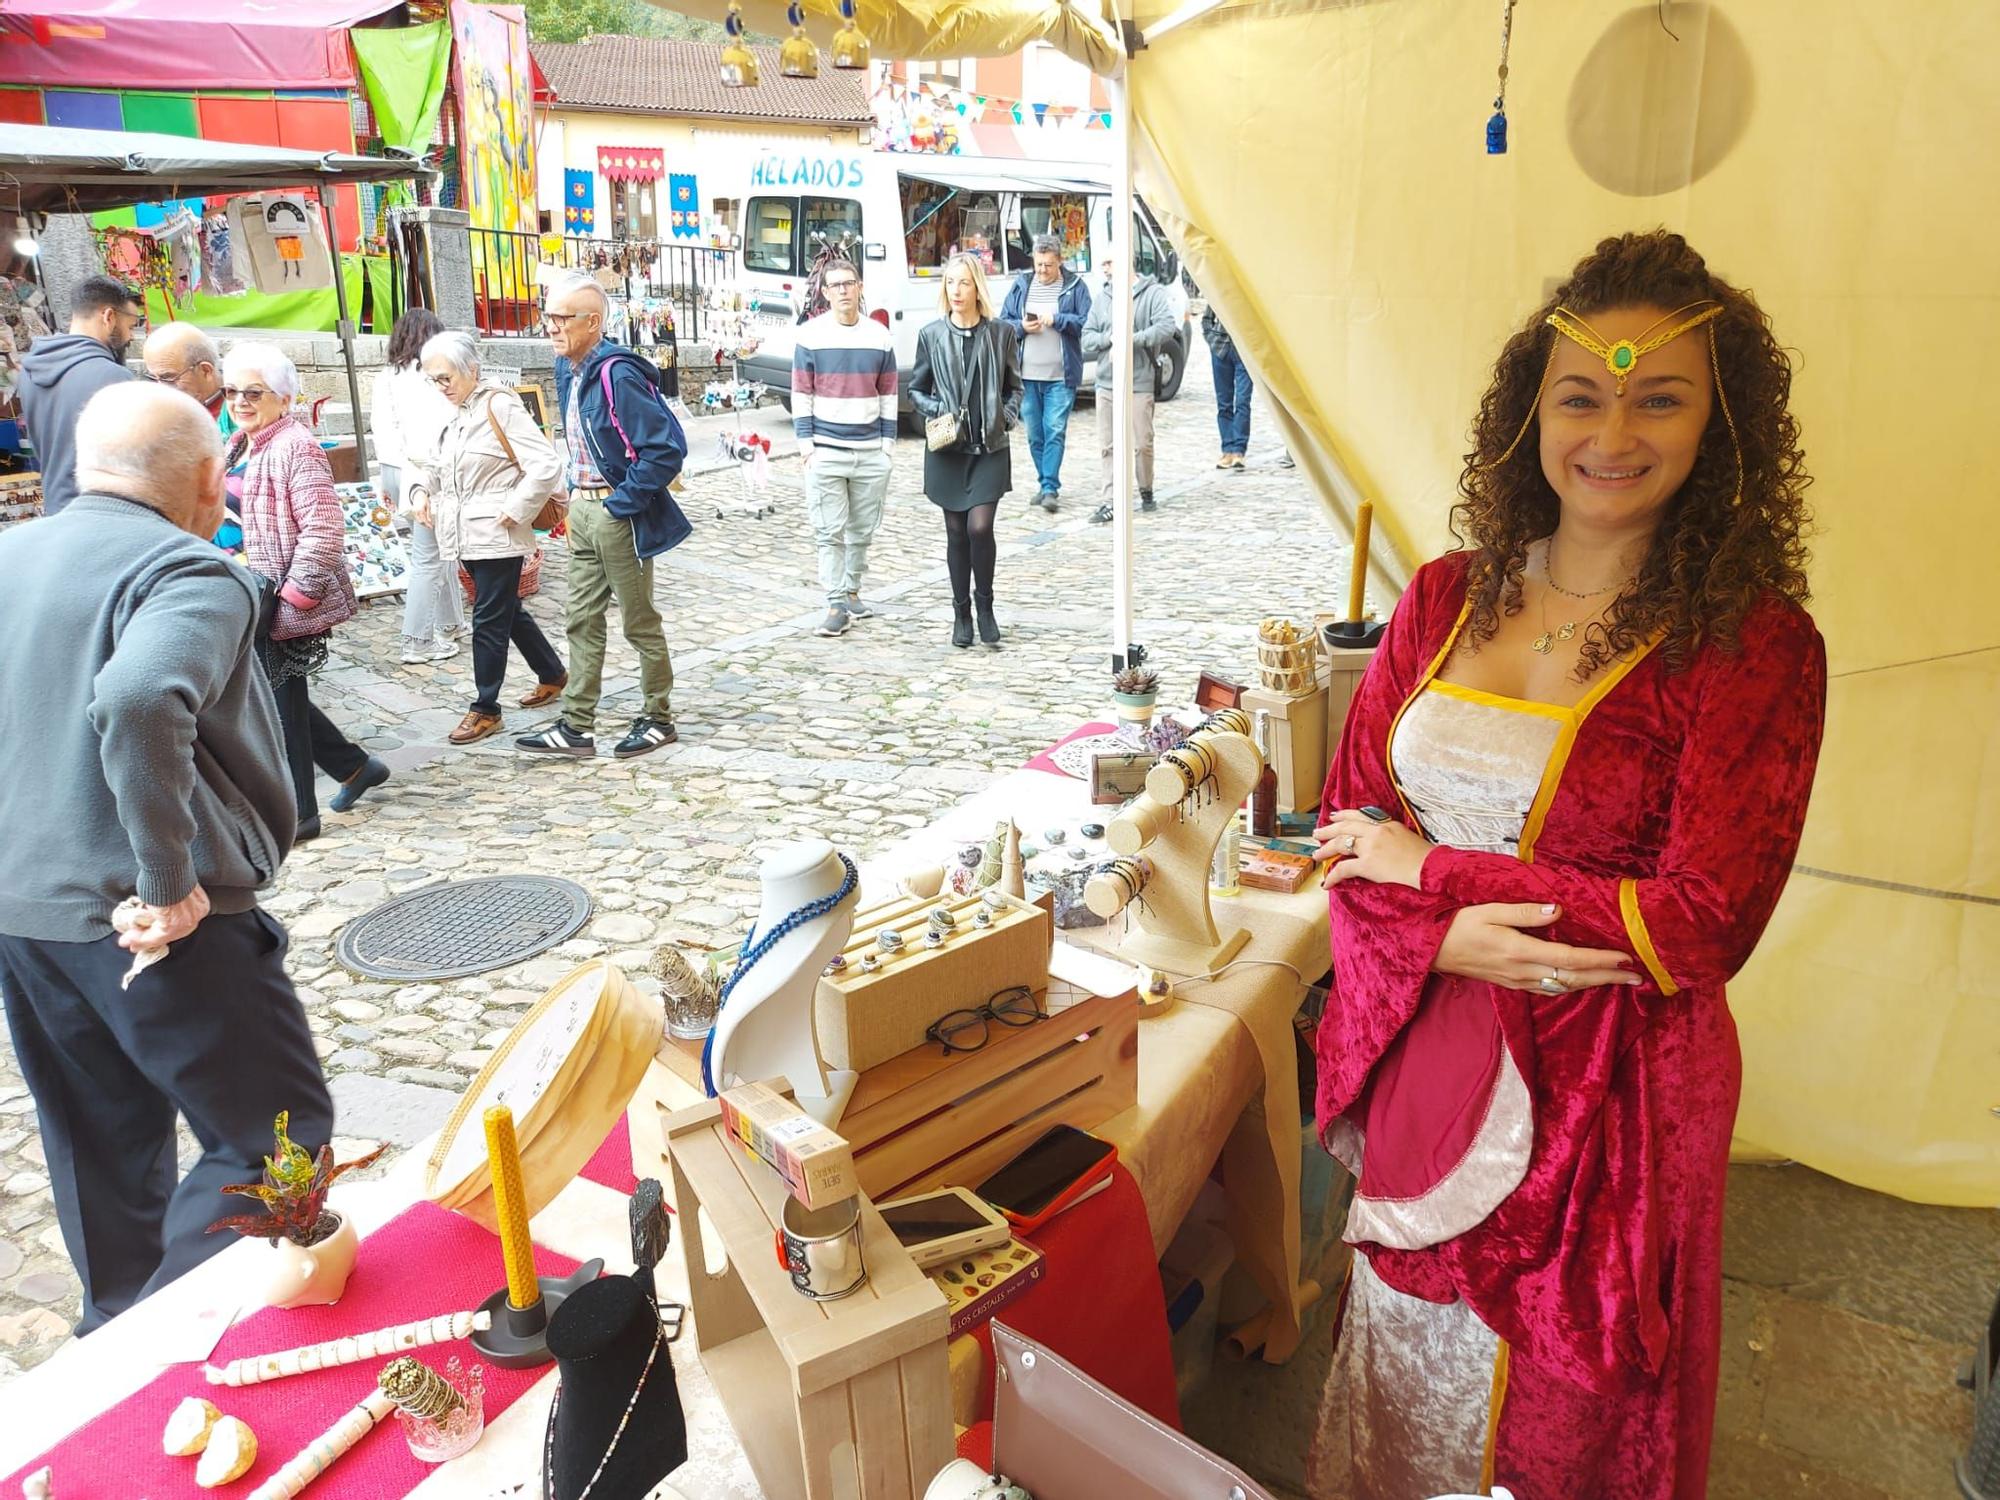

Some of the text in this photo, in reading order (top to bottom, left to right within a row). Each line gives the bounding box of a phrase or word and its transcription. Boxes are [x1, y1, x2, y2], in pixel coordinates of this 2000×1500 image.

[751, 157, 863, 188] HELADOS
[957, 1314, 972, 1329] LOS
[972, 1292, 1006, 1318] CRISTALES
